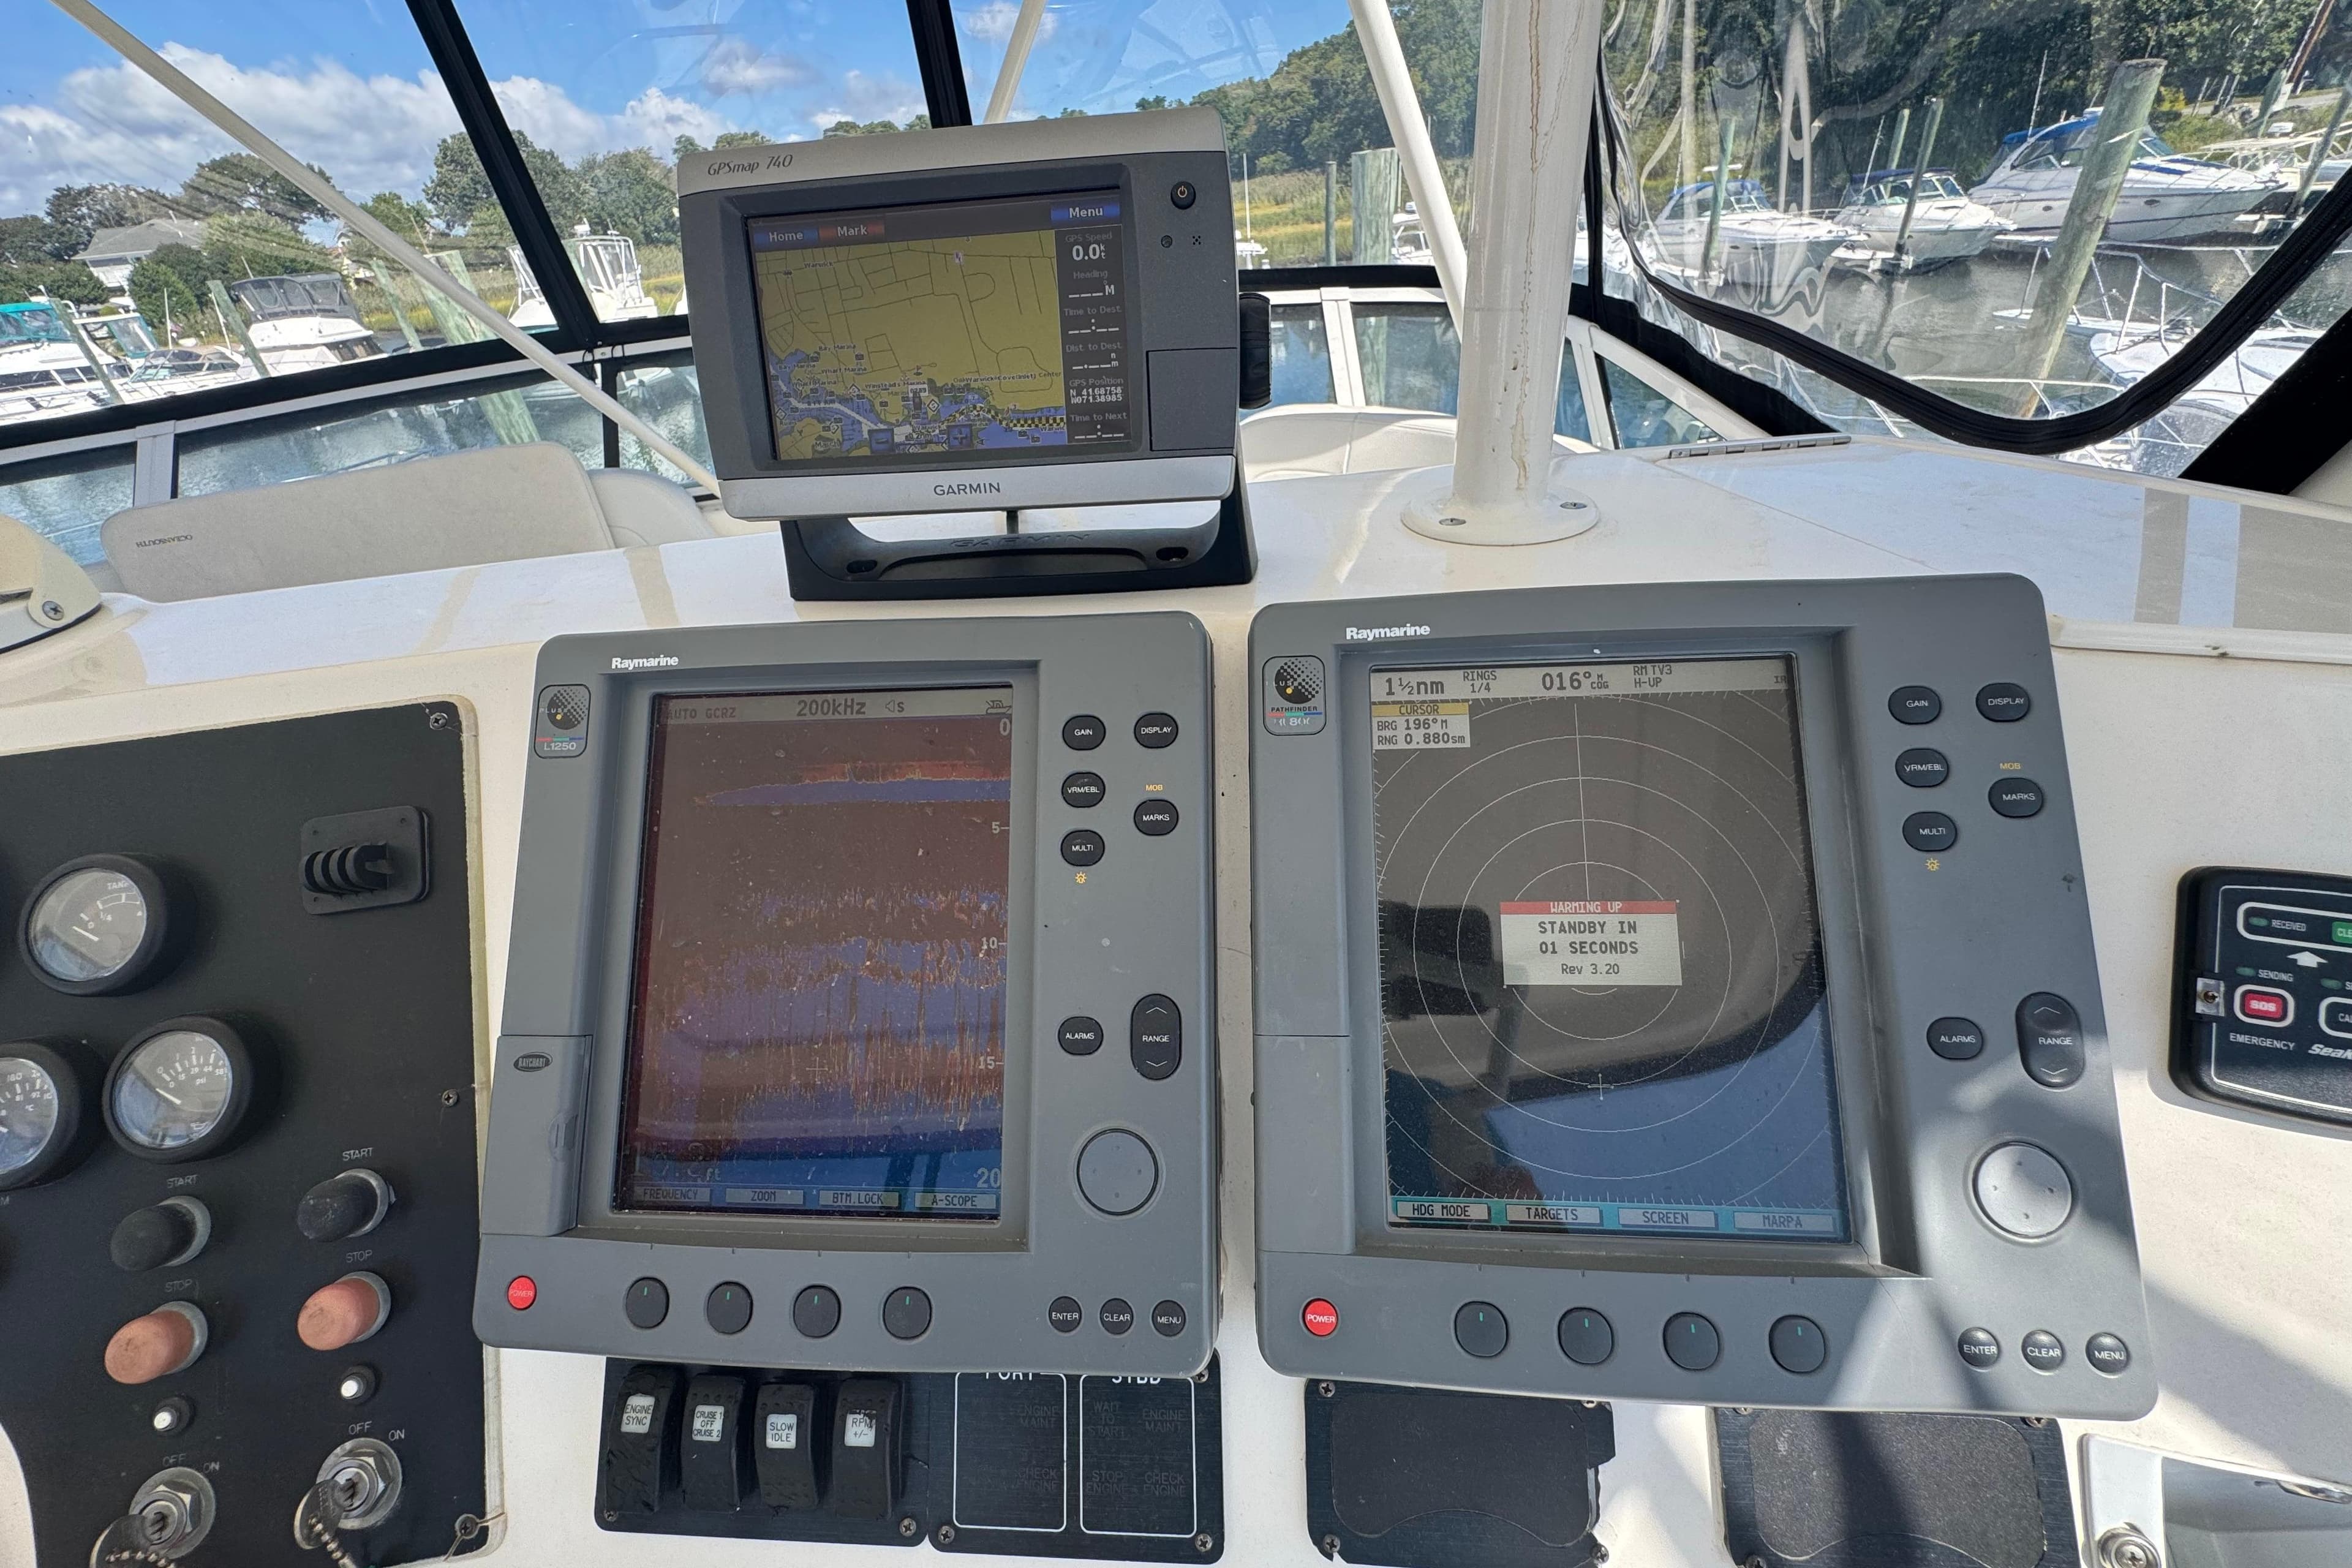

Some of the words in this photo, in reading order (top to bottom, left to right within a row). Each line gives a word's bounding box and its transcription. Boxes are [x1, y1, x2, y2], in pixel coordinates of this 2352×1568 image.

[707, 161, 760, 176] GPSmap
[767, 154, 793, 170] 740
[1069, 207, 1103, 218] Menu
[837, 224, 868, 237] Mark
[769, 231, 804, 243] Home
[1085, 231, 1112, 243] Speed
[1072, 244, 1100, 260] 0.0
[1073, 270, 1108, 279] Heading
[1066, 344, 1083, 352] Dist
[1105, 412, 1127, 420] Next
[933, 482, 1001, 496] GARMIN
[1346, 624, 1431, 641] Raymarine
[611, 654, 679, 670] Raymarine
[1463, 670, 1497, 682] RINGS
[1470, 682, 1490, 693] 1/4
[1591, 680, 1608, 690] COG
[1634, 677, 1662, 688] H-UP
[796, 698, 867, 717] 200kHz
[1988, 697, 2024, 706] DISPLAY
[666, 707, 698, 720] AUTO
[1398, 704, 1439, 715] CURSOR
[1000, 718, 1010, 736] 0
[1377, 720, 1397, 731] BRG
[544, 742, 576, 750] L1250
[1377, 735, 1397, 745] RNG
[1904, 763, 1944, 772] VRM/EBL
[1067, 785, 1100, 794] VRM/EBL
[992, 822, 1000, 834] 5
[1550, 902, 1600, 913] WARMING
[1608, 902, 1623, 913] UP
[1538, 921, 1606, 934] STANDBY
[1618, 921, 1637, 934] IN
[2271, 919, 2306, 932] RECEIVED
[1539, 941, 1558, 955] 01
[1569, 941, 1638, 954] SECONDS
[1561, 963, 1583, 975] Rev
[1591, 963, 1620, 974] 3.20
[2258, 969, 2293, 981] SENDING
[2250, 1000, 2277, 1012] SOS
[2230, 1033, 2295, 1051] EMERGENCY
[979, 1056, 995, 1070] 15
[342, 1147, 374, 1161] START
[167, 1174, 198, 1188] START
[976, 1168, 1001, 1188] 20
[643, 1188, 698, 1200] FREQUENCY
[750, 1190, 776, 1202] ZOOM
[930, 1194, 978, 1207] A-SCOPE
[1412, 1203, 1436, 1216] HDG
[1441, 1204, 1471, 1218] MODE
[1525, 1207, 1578, 1221] TARGETS
[1642, 1210, 1689, 1225] SCREEN
[1762, 1215, 1803, 1229] MARPA
[346, 1250, 372, 1263] STOP
[165, 1279, 192, 1292] STOP
[510, 1288, 533, 1297] POWER
[1052, 1312, 1079, 1321] ENTER
[1103, 1313, 1130, 1322] CLEAR
[1157, 1316, 1182, 1325] MENU
[1307, 1314, 1335, 1324] POWER
[1964, 1344, 1997, 1355] ENTER
[2027, 1347, 2061, 1358] CLEAR
[2095, 1351, 2124, 1360] MENU
[625, 1404, 653, 1415] ENGINE
[696, 1410, 718, 1419] CRUISE
[1142, 1409, 1186, 1421] ENGINE
[625, 1415, 647, 1426] SYNC
[700, 1419, 714, 1428] OFF
[769, 1422, 794, 1431] SLOW
[852, 1417, 872, 1428] RPM
[348, 1421, 372, 1435] OFF
[692, 1428, 715, 1438] CRUISE
[715, 1430, 721, 1438] 2
[1145, 1421, 1182, 1433] MAINT
[388, 1429, 405, 1441] ON
[771, 1432, 791, 1442] IDLE
[162, 1453, 186, 1467] OFF
[203, 1461, 220, 1473] ON
[1091, 1470, 1123, 1482] STOP
[1144, 1472, 1185, 1485] CHECK
[1086, 1483, 1126, 1496] ENGINE
[1144, 1485, 1186, 1498] ENGINE
